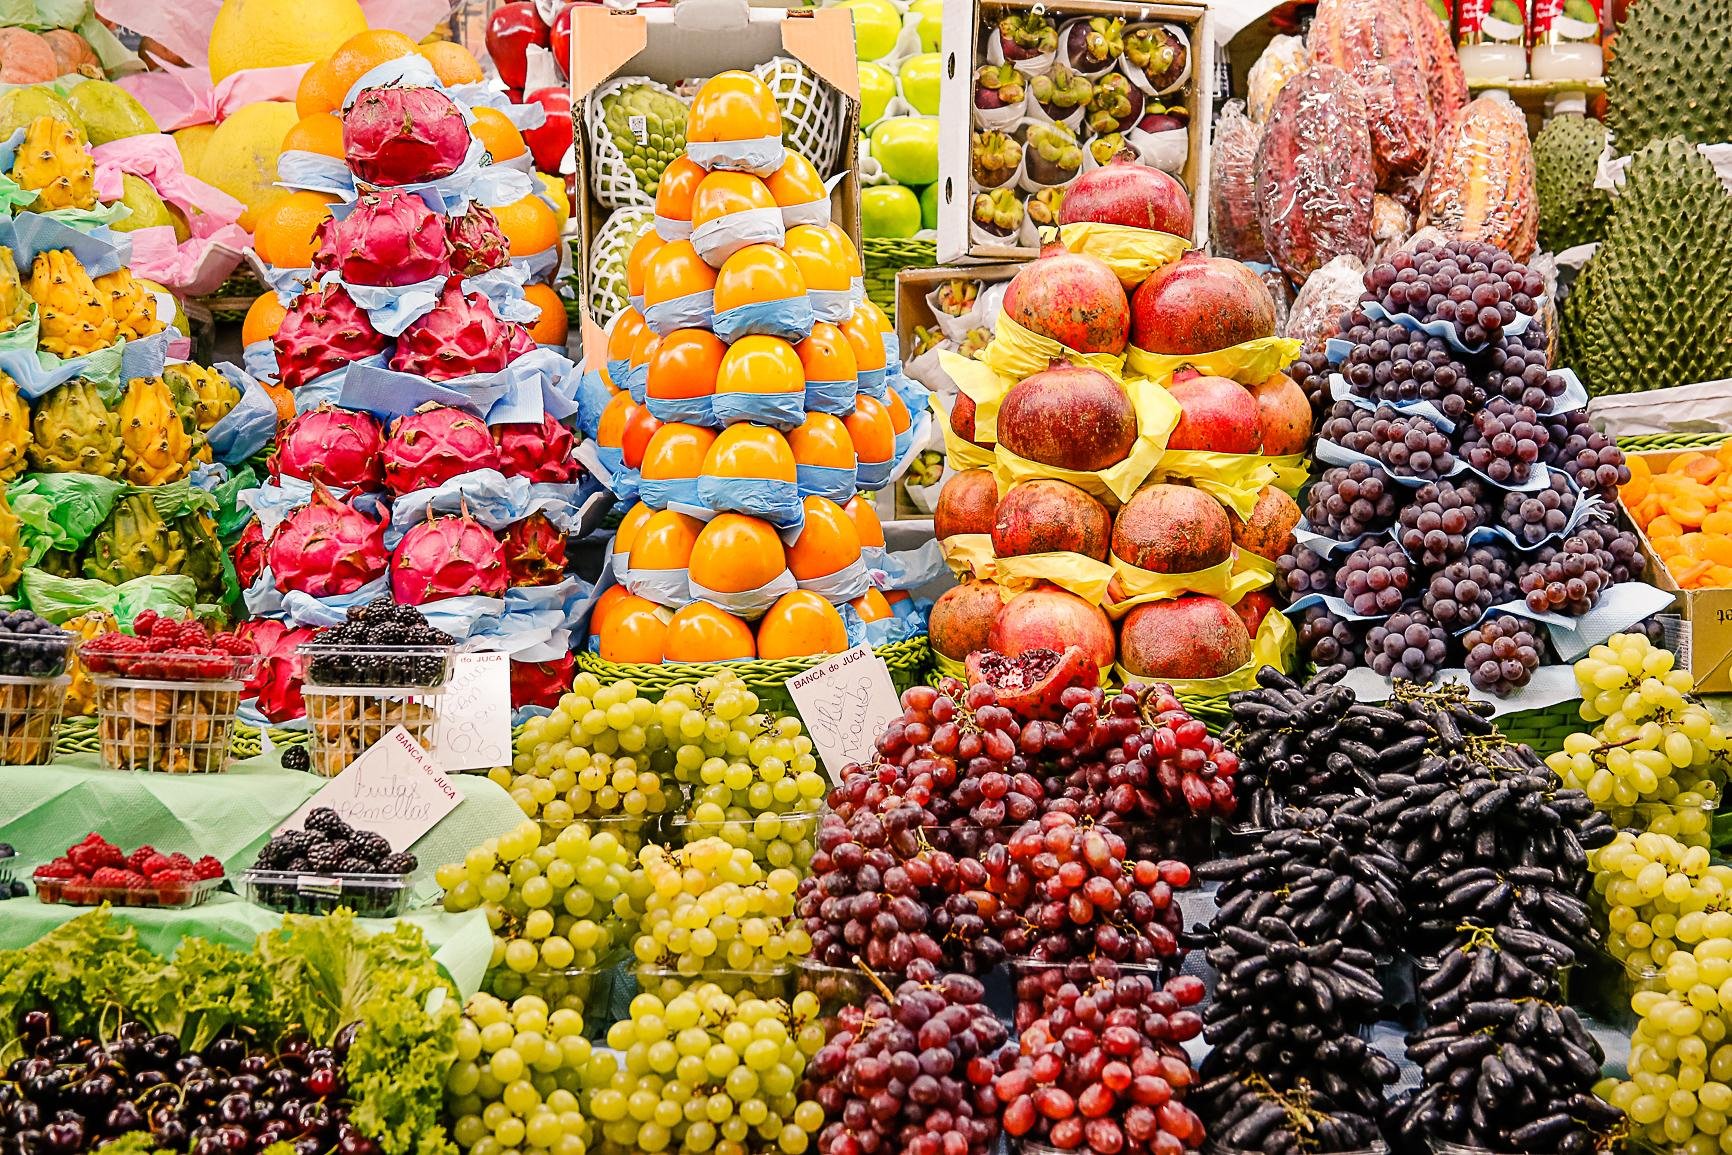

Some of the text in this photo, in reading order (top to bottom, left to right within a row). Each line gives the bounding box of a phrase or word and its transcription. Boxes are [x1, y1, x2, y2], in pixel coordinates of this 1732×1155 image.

[477, 655, 502, 663] JUCA
[794, 650, 866, 689] BANCA do JUCA
[395, 733, 456, 800] BANCA do JUCA
